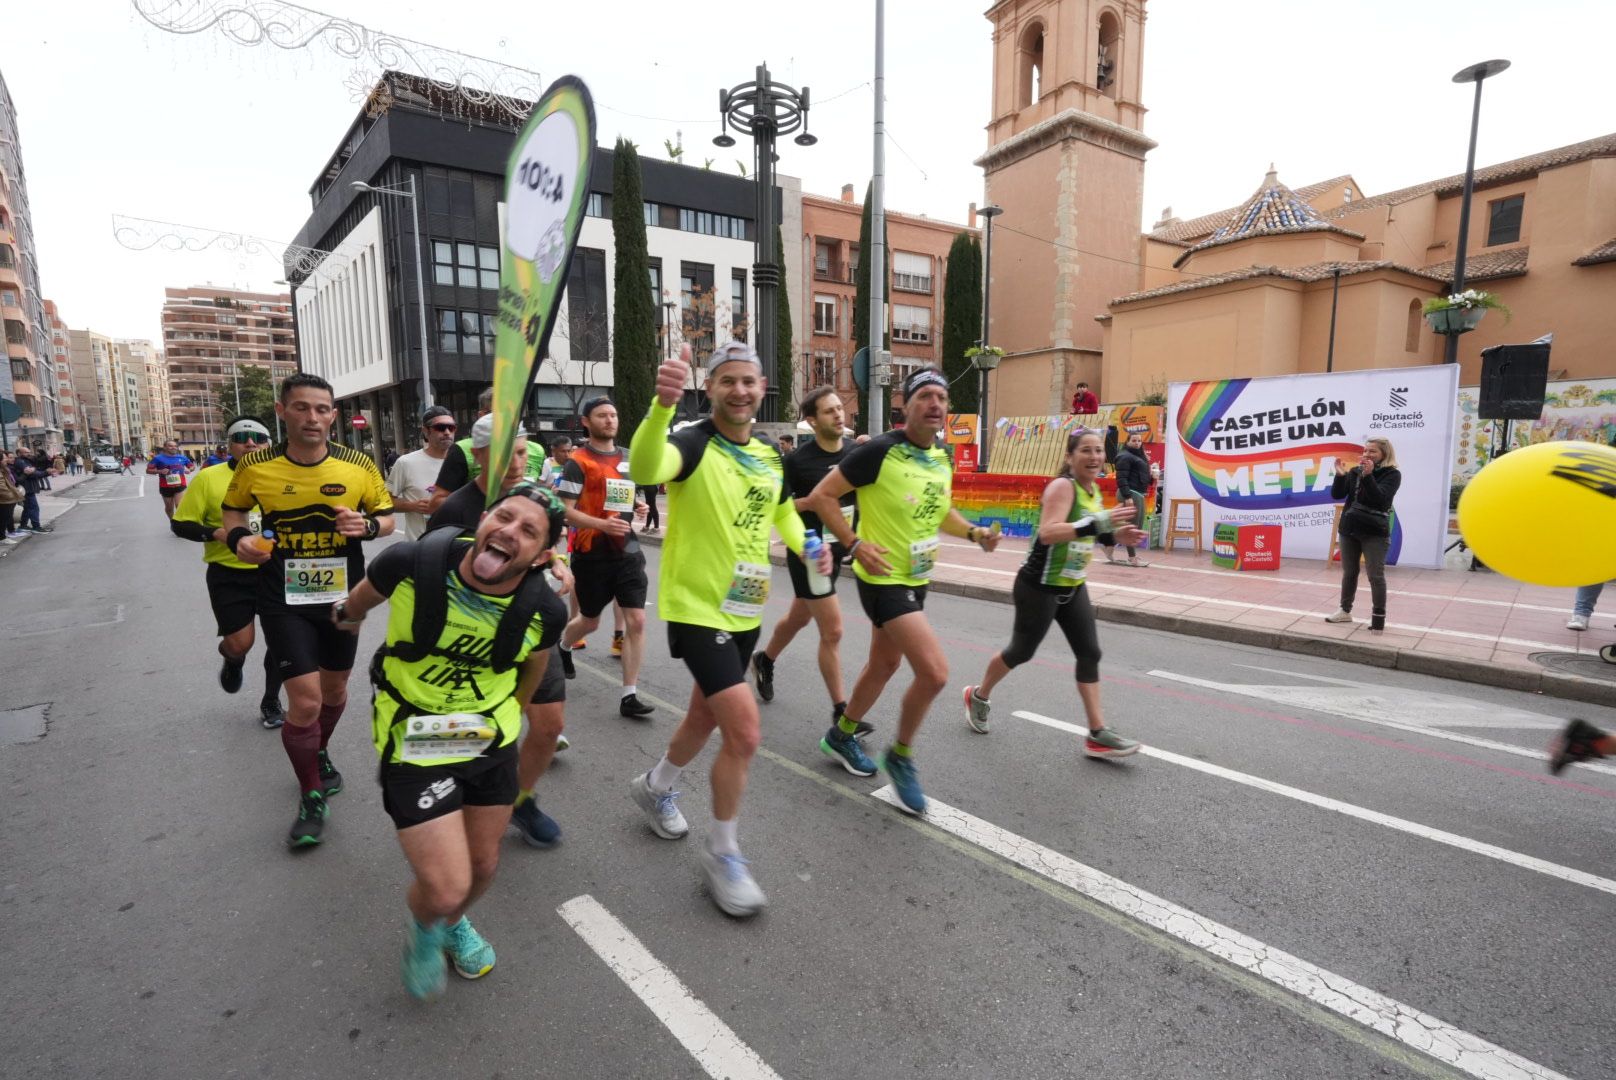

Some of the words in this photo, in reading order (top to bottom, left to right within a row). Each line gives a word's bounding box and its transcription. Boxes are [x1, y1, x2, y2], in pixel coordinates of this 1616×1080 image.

[1210, 398, 1345, 432] CASTELLÓN
[1372, 411, 1423, 422] Diputació
[1369, 421, 1382, 429] de
[1383, 419, 1425, 429] Castelló
[1210, 428, 1282, 450] TIENE
[1288, 421, 1346, 440] UNA
[1238, 513, 1281, 521] PROVINCIA
[1283, 511, 1310, 521] UNIDA
[1311, 510, 1334, 519] CONT
[1284, 520, 1296, 528] EN
[277, 531, 347, 549] XTREM
[1214, 544, 1235, 555] META
[298, 570, 334, 587] 942
[306, 585, 327, 593] ENZO
